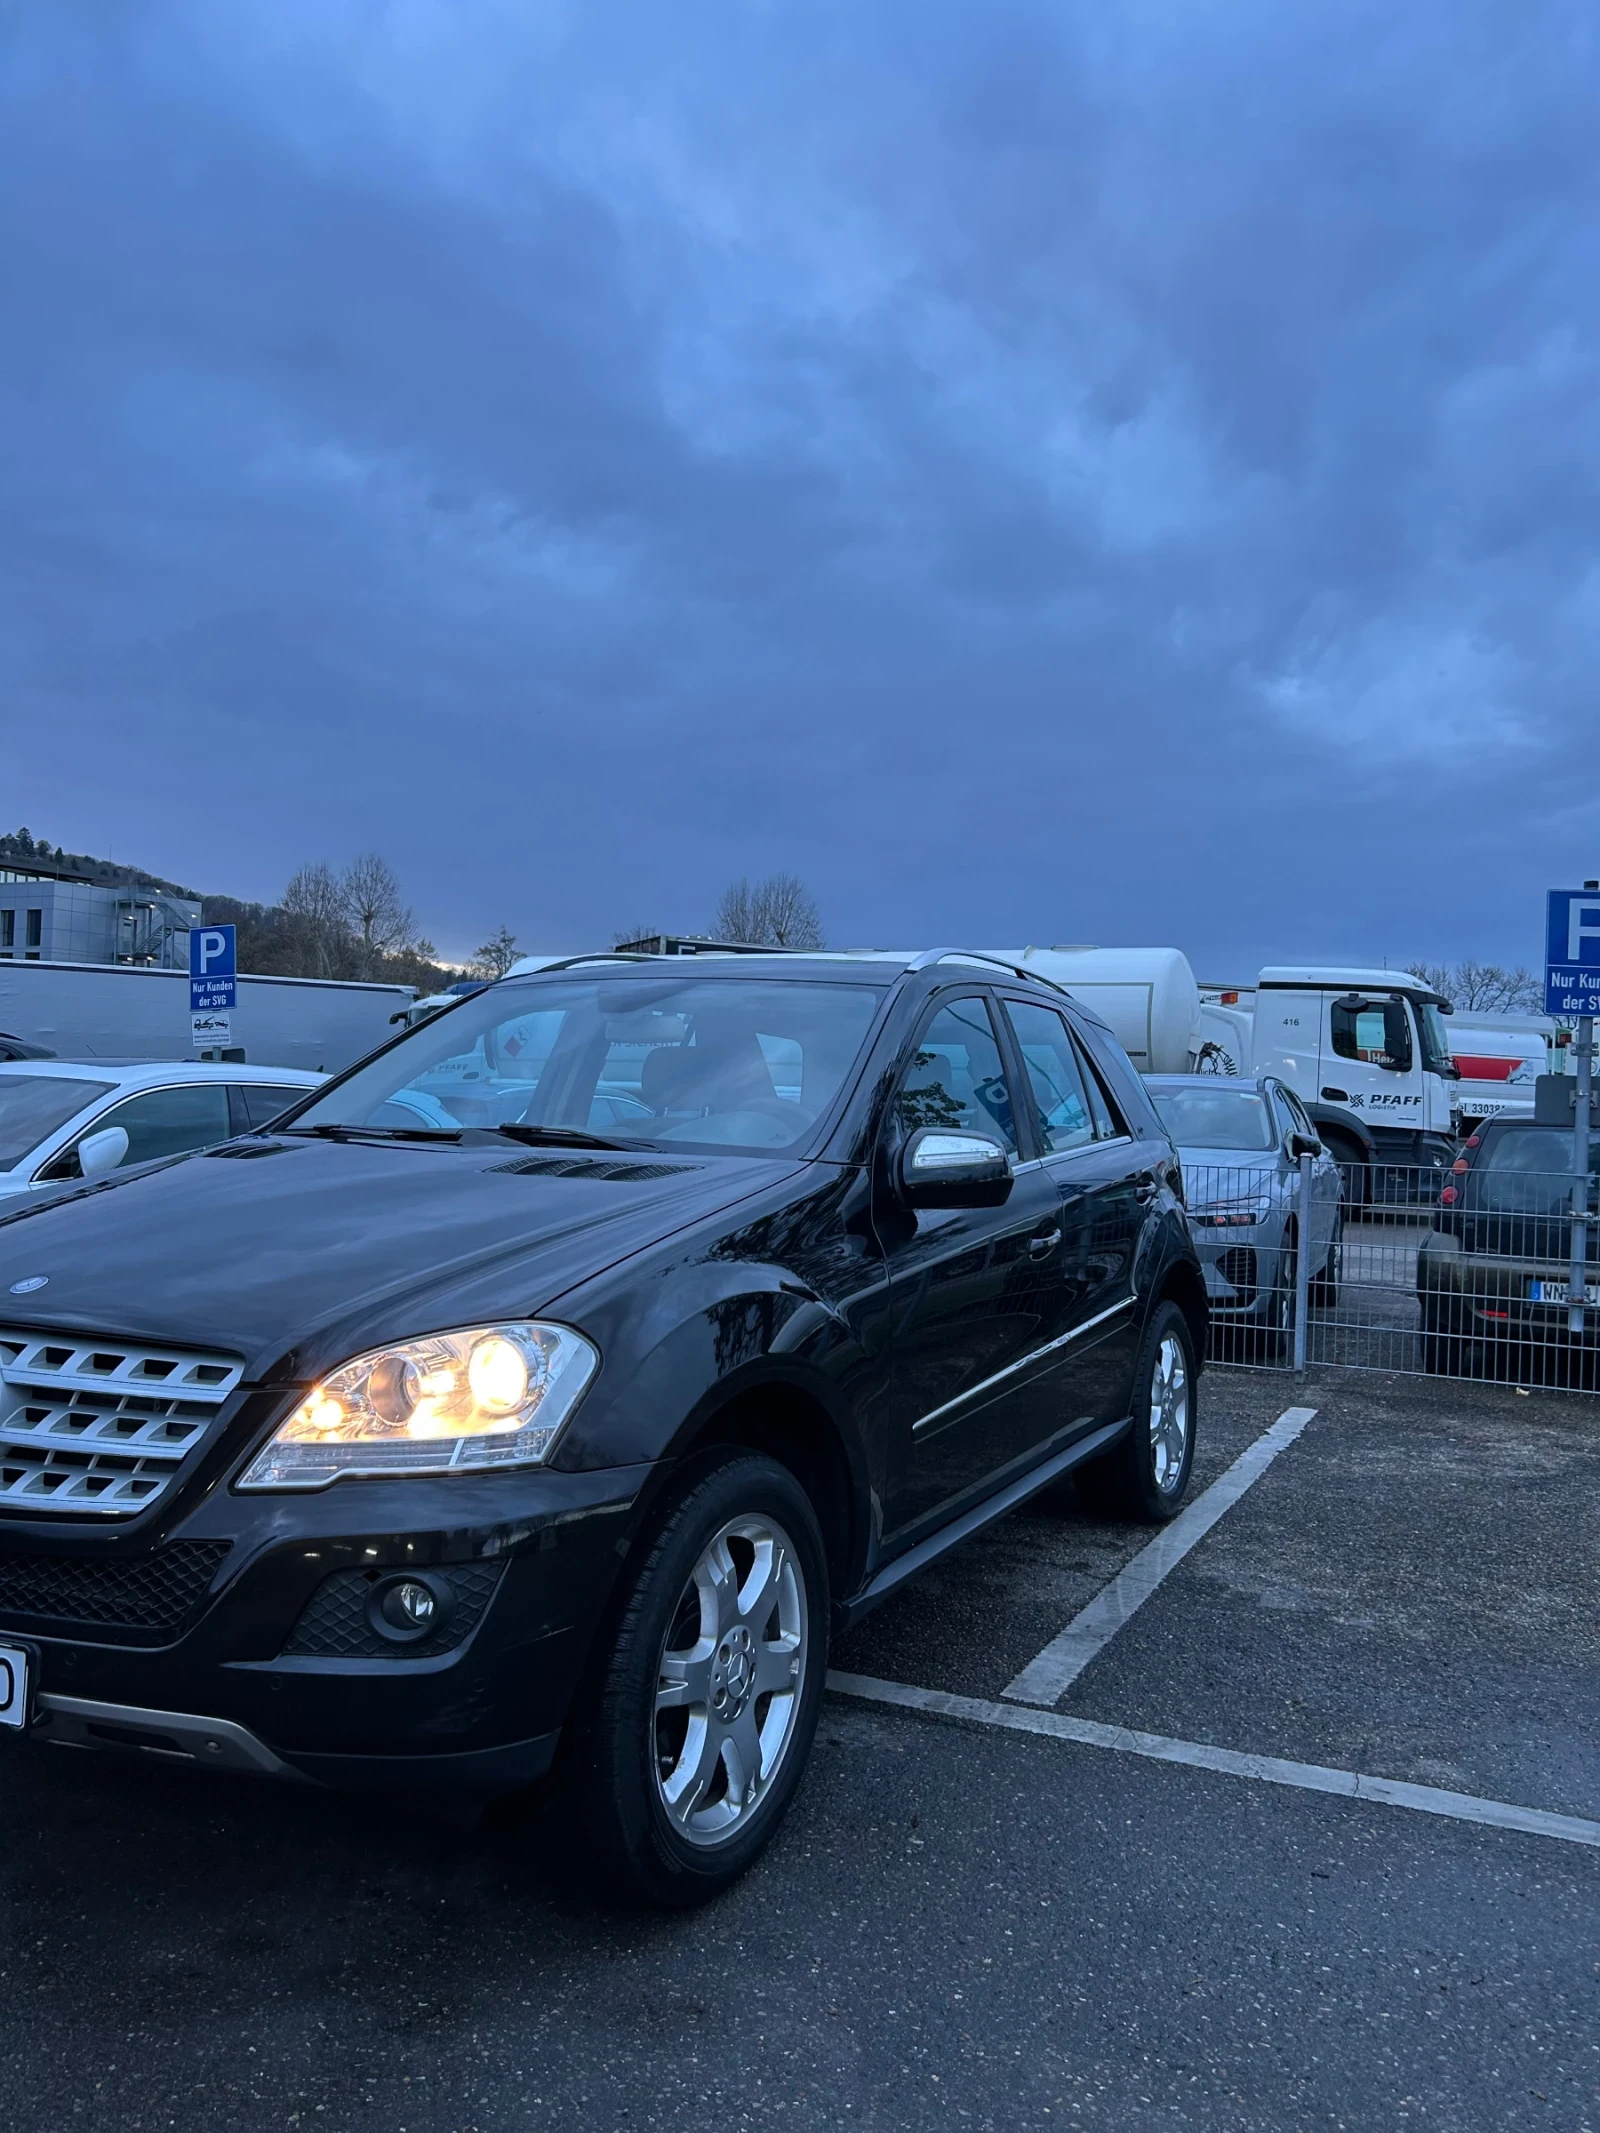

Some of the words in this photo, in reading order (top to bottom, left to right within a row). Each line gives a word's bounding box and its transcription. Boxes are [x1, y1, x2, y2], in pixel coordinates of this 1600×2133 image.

[200, 931, 226, 974] P
[192, 982, 205, 993] Nur
[206, 980, 233, 992] Kunden
[1551, 972, 1575, 988] Nur
[199, 996, 211, 1007] der
[212, 995, 227, 1006] SVG
[1562, 994, 1585, 1010] der
[1282, 1018, 1300, 1026] 416
[1369, 1094, 1423, 1106] PFAFF
